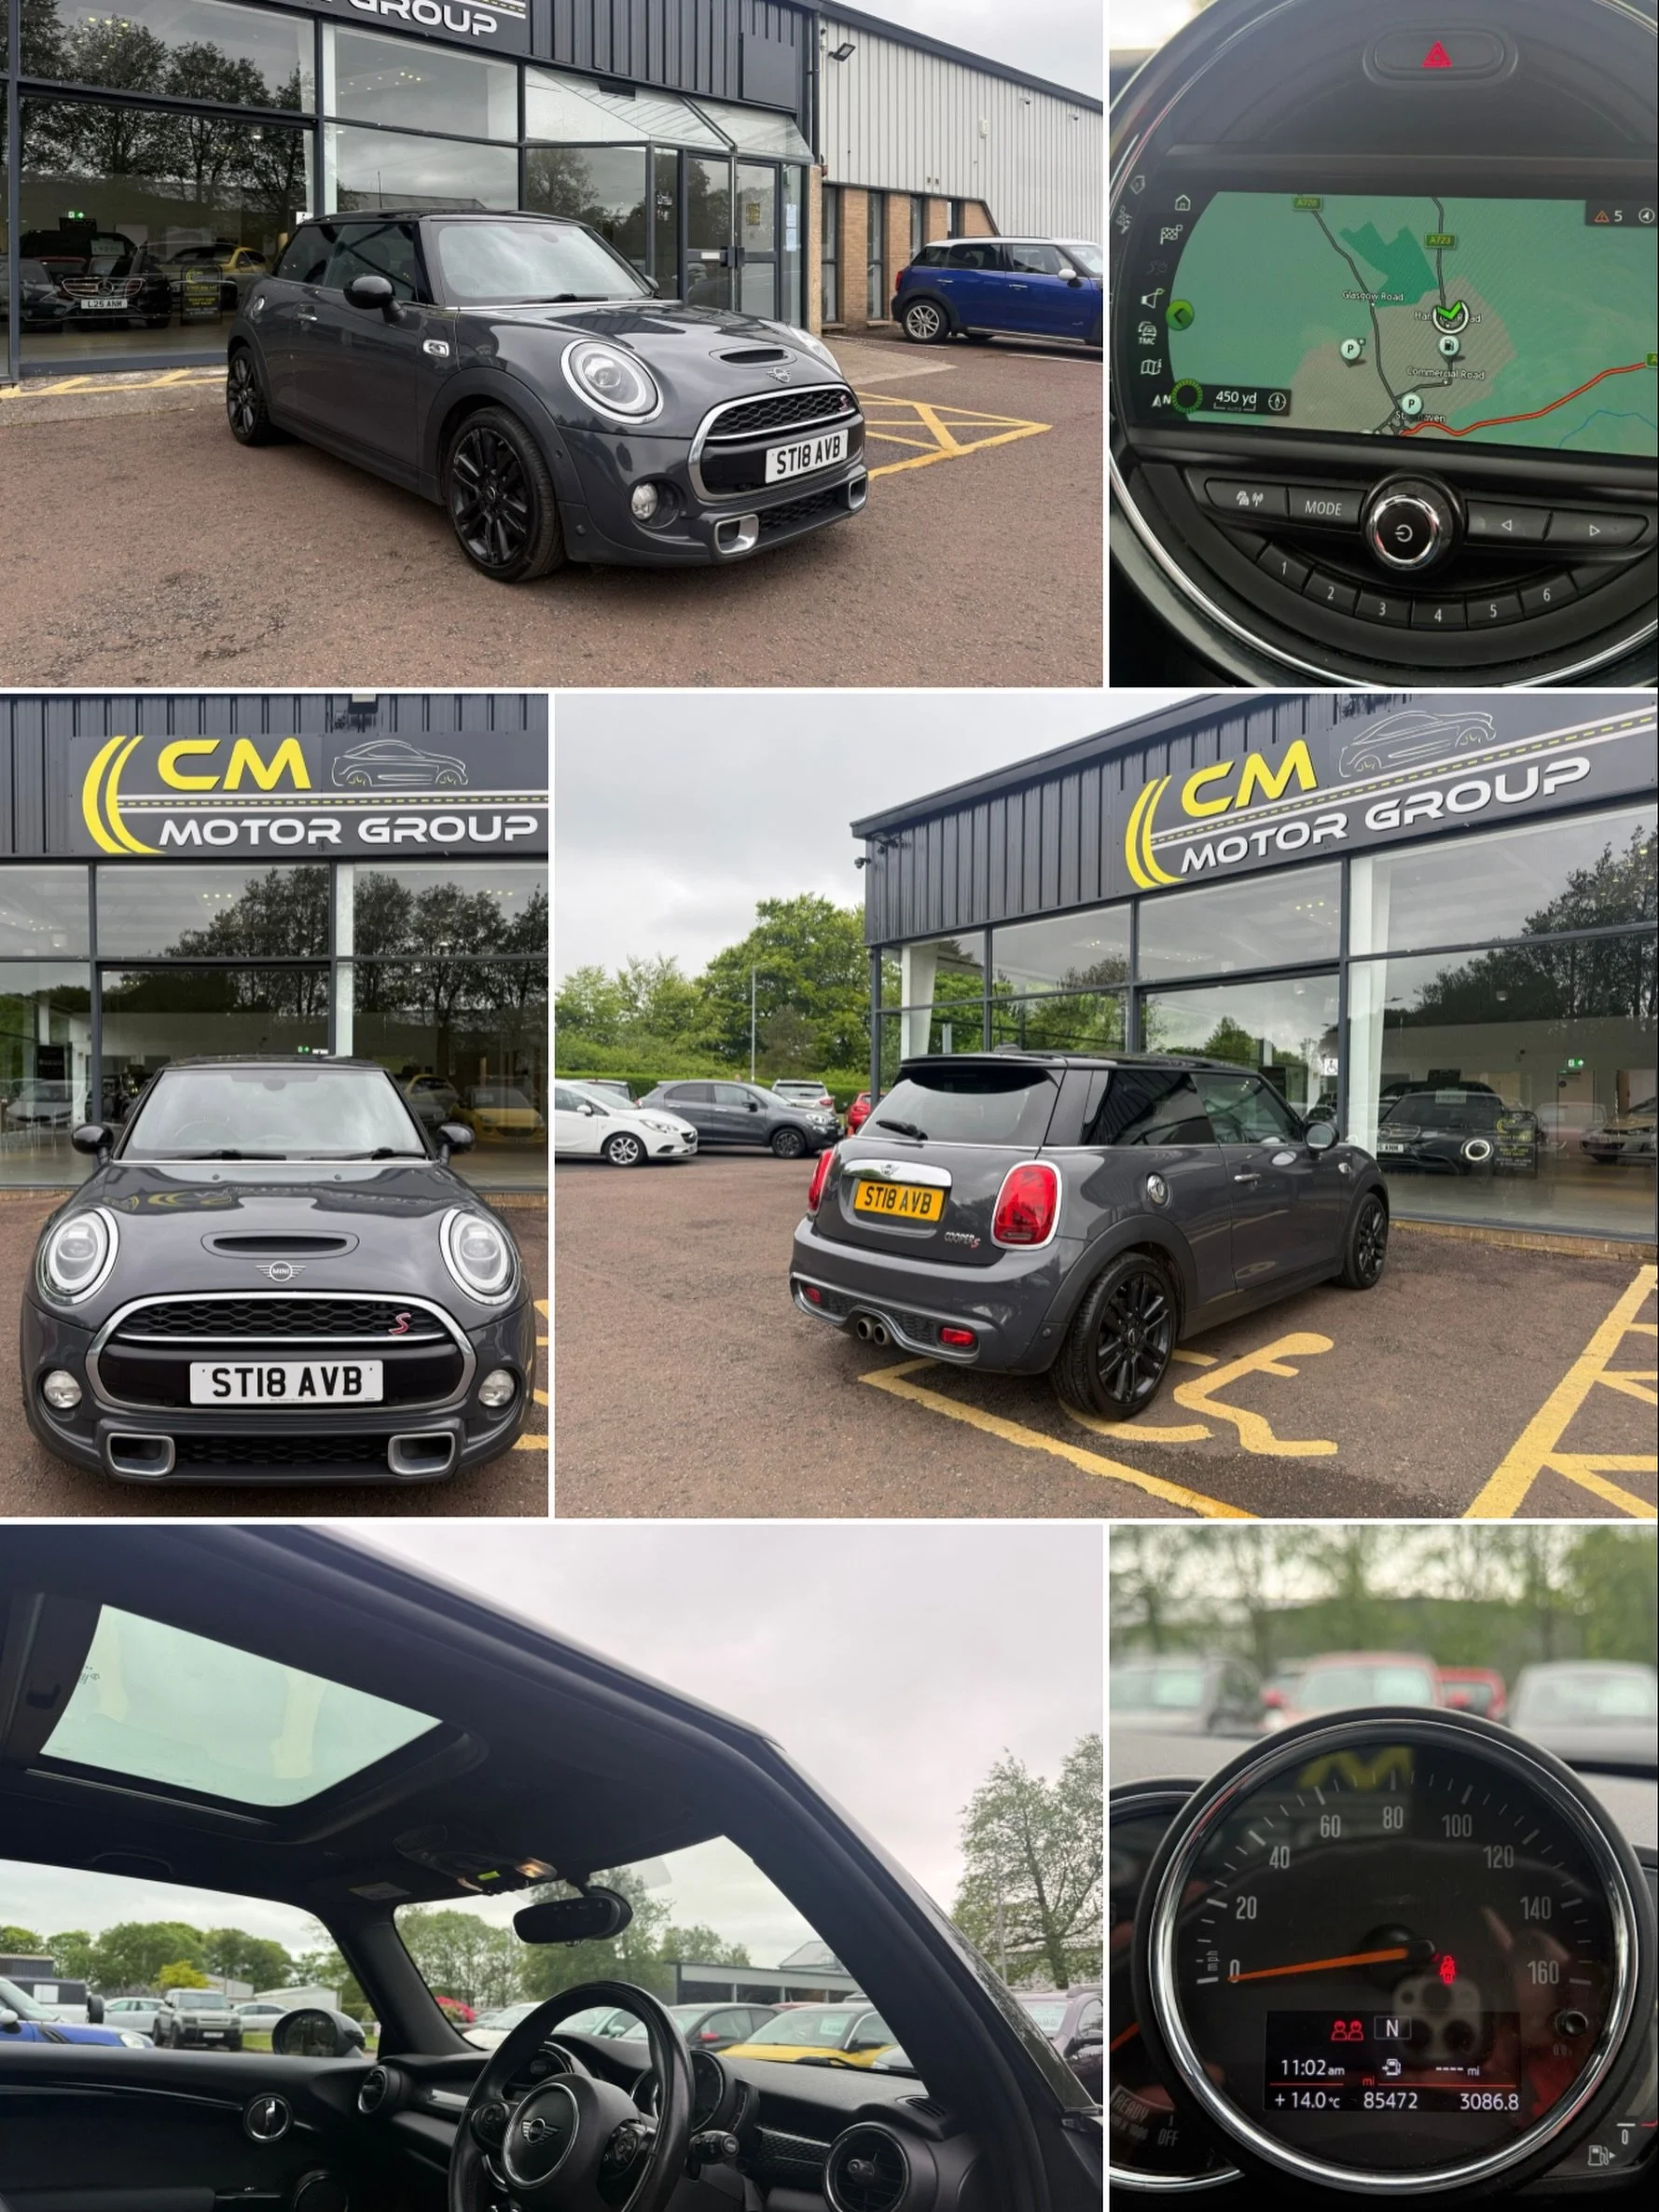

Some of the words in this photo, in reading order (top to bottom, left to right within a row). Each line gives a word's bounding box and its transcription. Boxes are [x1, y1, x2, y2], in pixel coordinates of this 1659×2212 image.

[1614, 210, 1623, 222] 5
[1342, 290, 1378, 301] Glasgow
[1381, 292, 1403, 301] Road
[1457, 313, 1482, 324] Rad
[1138, 337, 1155, 345] TMC
[1406, 366, 1459, 378] Commercial
[1460, 367, 1485, 380] Road
[1163, 394, 1171, 405] N
[1216, 391, 1239, 403] 450
[1242, 392, 1257, 406] yd
[777, 444, 811, 475] ST18
[815, 435, 840, 464] AVB
[1306, 500, 1342, 516] MODE
[1281, 561, 1287, 574] 1
[1327, 586, 1334, 601] 2
[1543, 588, 1551, 601] 6
[1378, 601, 1386, 616] 3
[1434, 608, 1442, 623] 4
[1490, 604, 1497, 618] 5
[157, 738, 311, 792] CM
[1181, 739, 1319, 818] CM
[1180, 814, 1348, 875] MOTOR
[1364, 756, 1592, 833] GROUP
[159, 819, 342, 847] MOTOR
[357, 815, 539, 844] GROUP
[864, 1185, 897, 1210] ST18
[899, 1190, 933, 1214] AVB
[944, 1231, 975, 1244] COOPER
[971, 1237, 981, 1249] S
[388, 1312, 411, 1334] S
[212, 1367, 286, 1397] ST18
[297, 1366, 362, 1396] AVB
[1320, 1814, 1341, 1838] 60
[1382, 1805, 1403, 1829] 80
[1442, 1814, 1472, 1837] 100
[1269, 1846, 1290, 1869] 40
[1483, 1845, 1514, 1868] 120
[1236, 1896, 1257, 1919] 20
[1520, 1896, 1552, 1919] 140
[1207, 1950, 1220, 1971] mph
[1230, 1958, 1240, 1983] 0
[1527, 1960, 1559, 1984] 160
[1385, 2019, 1399, 2038] N
[1362, 2076, 1376, 2086] mi
[1467, 2066, 1480, 2077] mi
[1113, 2093, 1150, 2122] READY
[1363, 2092, 1417, 2109] 85472
[1459, 2093, 1519, 2110] 3086.8
[1157, 2128, 1179, 2147] OFF
[1621, 2129, 1629, 2145] 0
